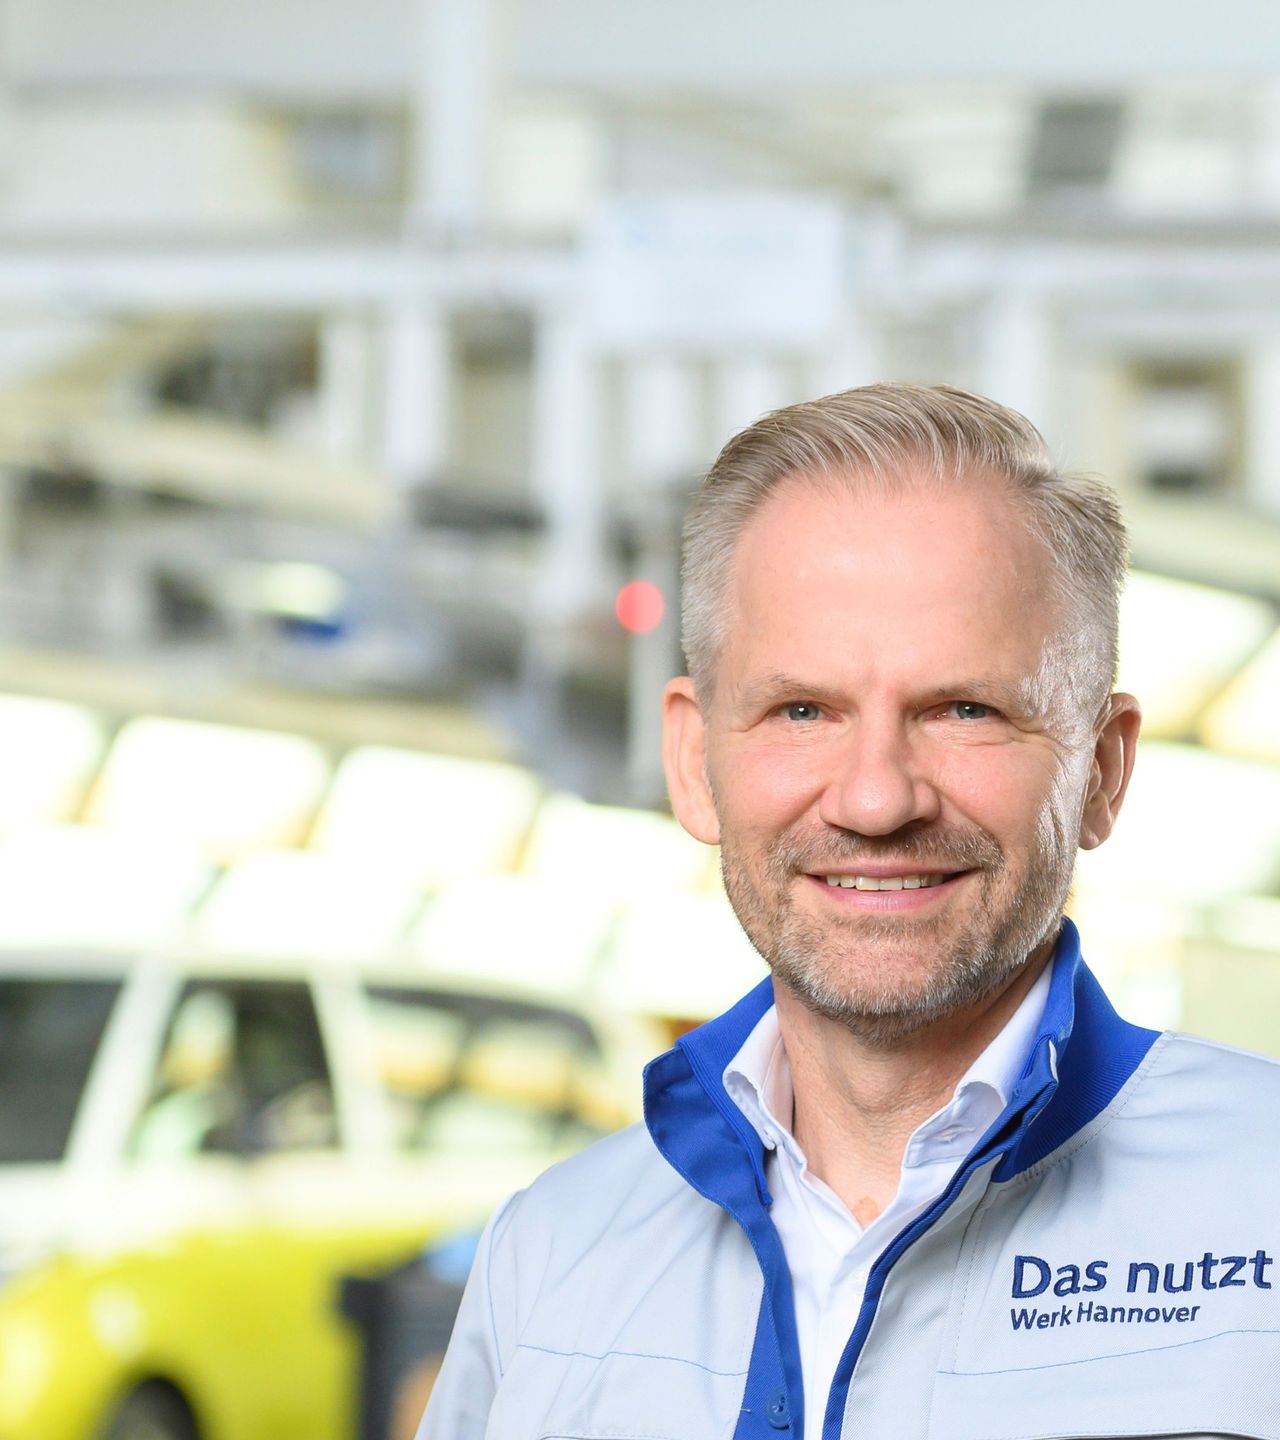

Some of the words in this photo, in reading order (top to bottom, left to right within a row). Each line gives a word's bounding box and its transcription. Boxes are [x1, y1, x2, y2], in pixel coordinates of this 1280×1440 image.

[1011, 1254, 1108, 1299] Das
[1126, 1250, 1273, 1294] nutzt
[1010, 1304, 1072, 1330] Werk
[1076, 1301, 1200, 1323] Hannover
